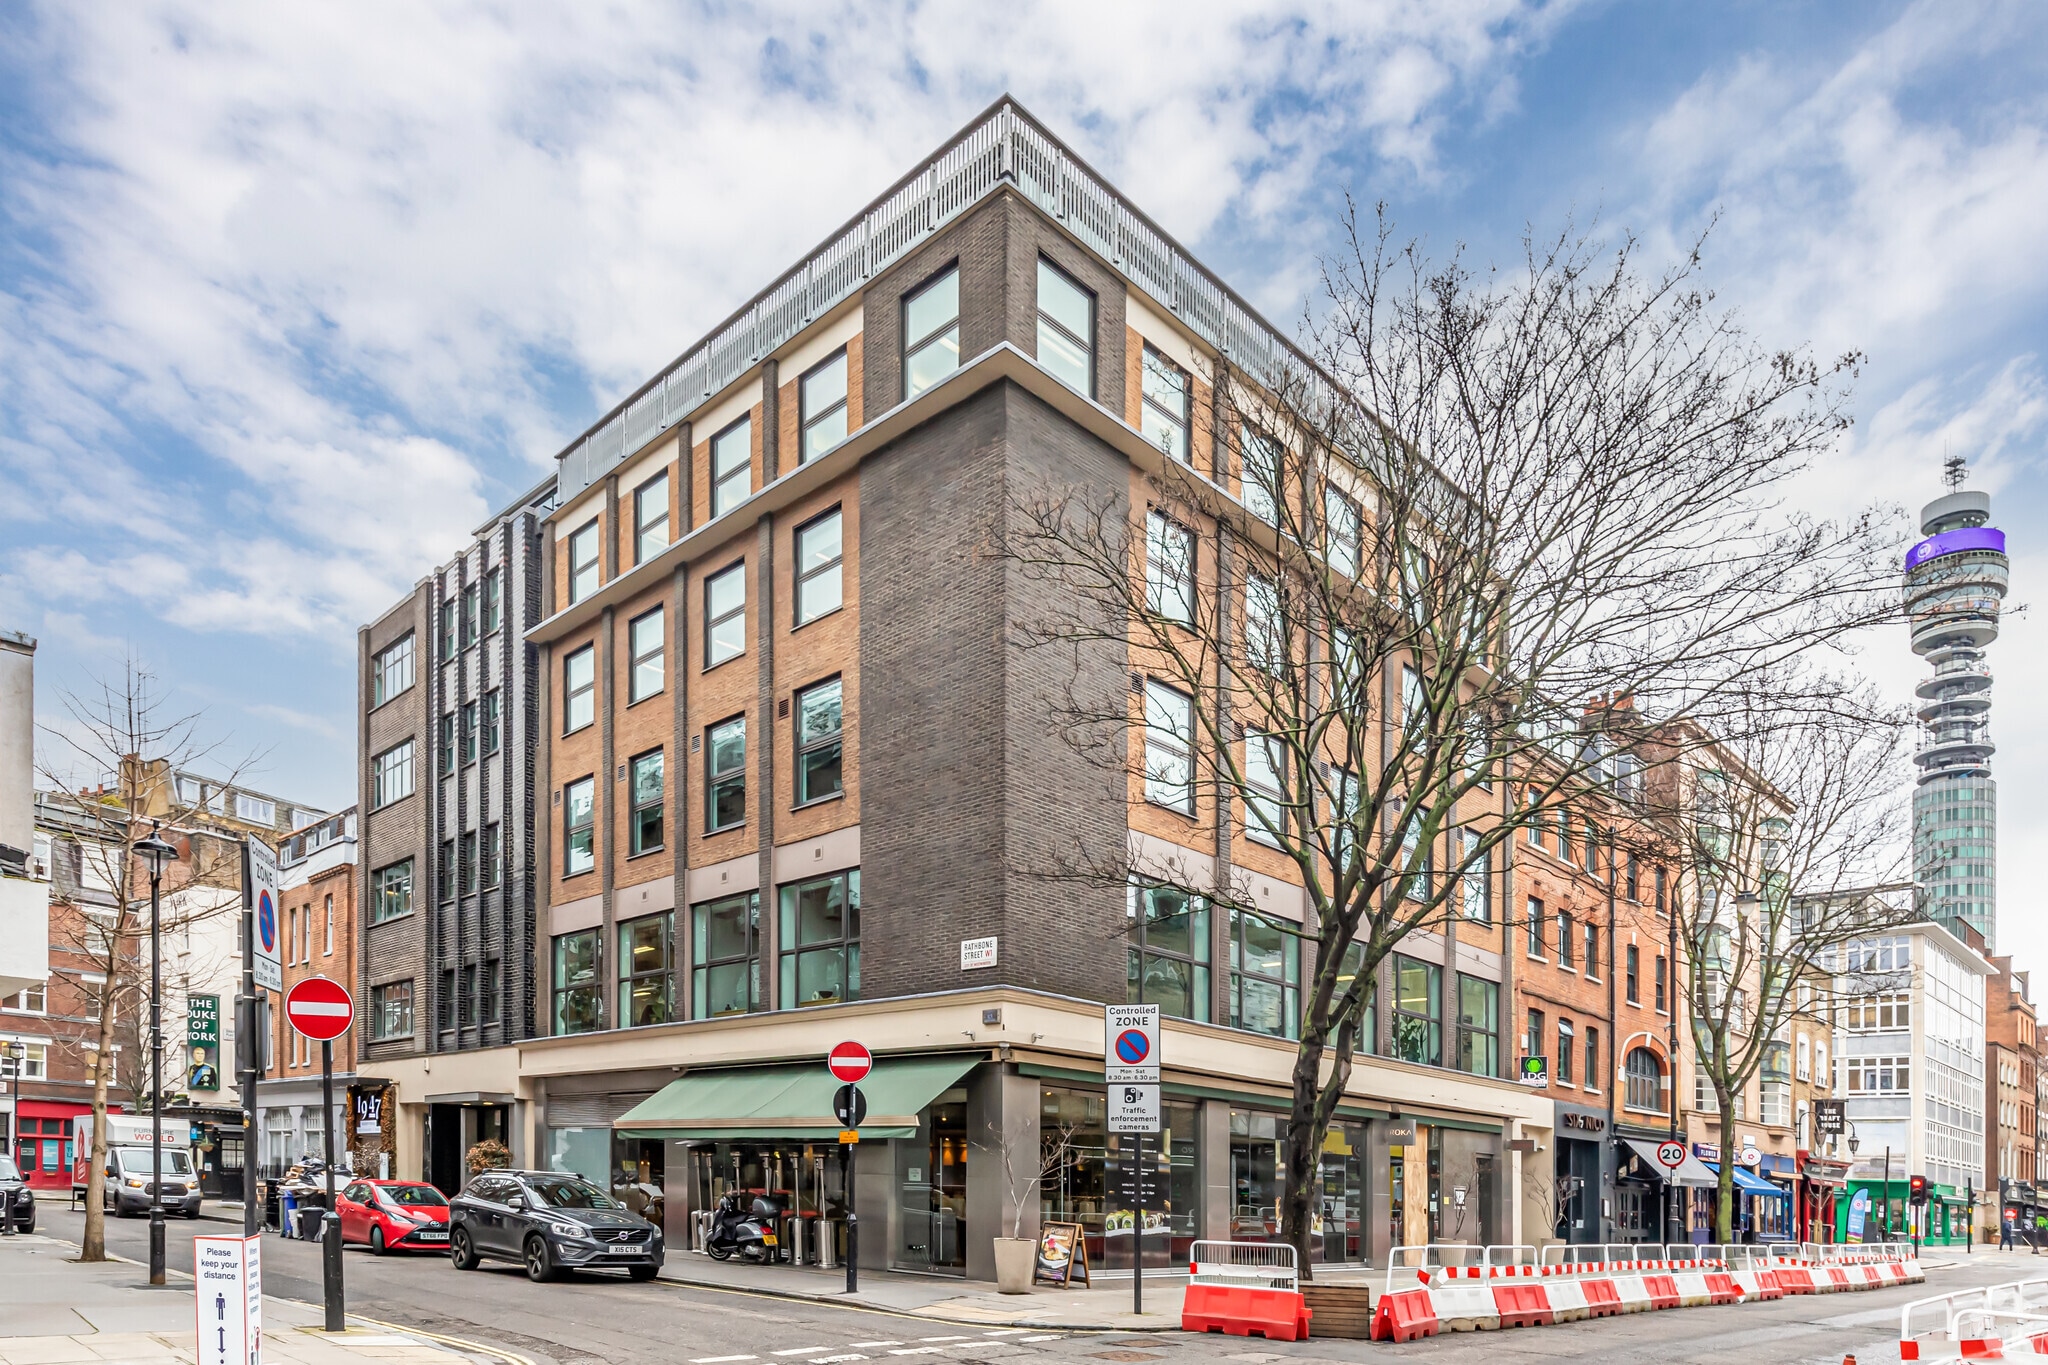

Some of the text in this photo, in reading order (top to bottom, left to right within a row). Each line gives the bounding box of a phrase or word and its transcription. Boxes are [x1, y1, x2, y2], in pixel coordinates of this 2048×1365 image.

[252, 841, 275, 869] Controlled
[256, 863, 273, 888] ZONE
[964, 940, 993, 951] RATHBONE
[964, 949, 993, 960] STREET W1
[190, 999, 213, 1009] THE
[188, 1010, 217, 1020] DUKE
[1110, 1007, 1156, 1015] Controlled
[192, 1021, 209, 1030] OF
[1116, 1017, 1149, 1026] ZONE
[188, 1032, 217, 1042] YORK
[1522, 1072, 1546, 1080] LDG
[357, 1095, 382, 1120] 1947
[134, 1134, 175, 1143] WOLD
[1662, 1149, 1681, 1160] 20
[207, 1248, 232, 1257] Please
[201, 1259, 219, 1269] keep
[221, 1262, 238, 1270] your
[204, 1271, 236, 1281] distance
